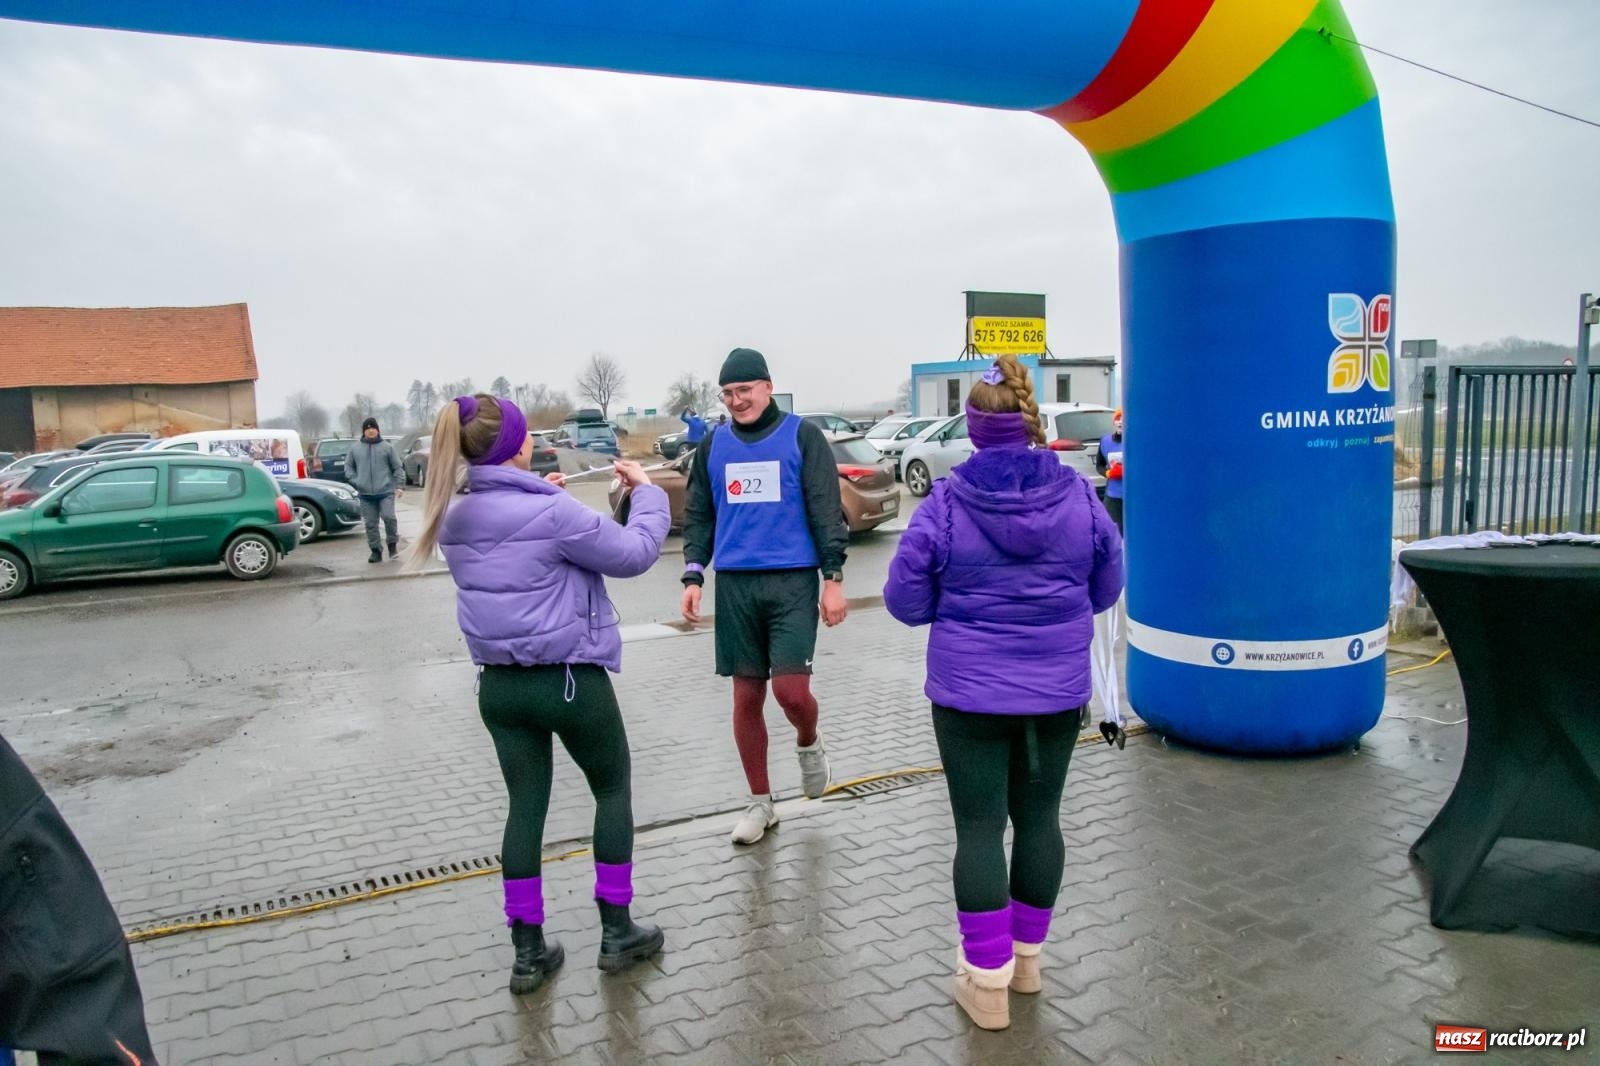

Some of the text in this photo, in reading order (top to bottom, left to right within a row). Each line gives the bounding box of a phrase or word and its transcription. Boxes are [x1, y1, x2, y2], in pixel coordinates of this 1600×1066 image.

[974, 329, 1044, 343] 575 792 626
[1260, 409, 1330, 429] GMINA
[1307, 437, 1338, 448] odkryj
[1344, 436, 1370, 447] poznaj
[742, 478, 762, 494] 22
